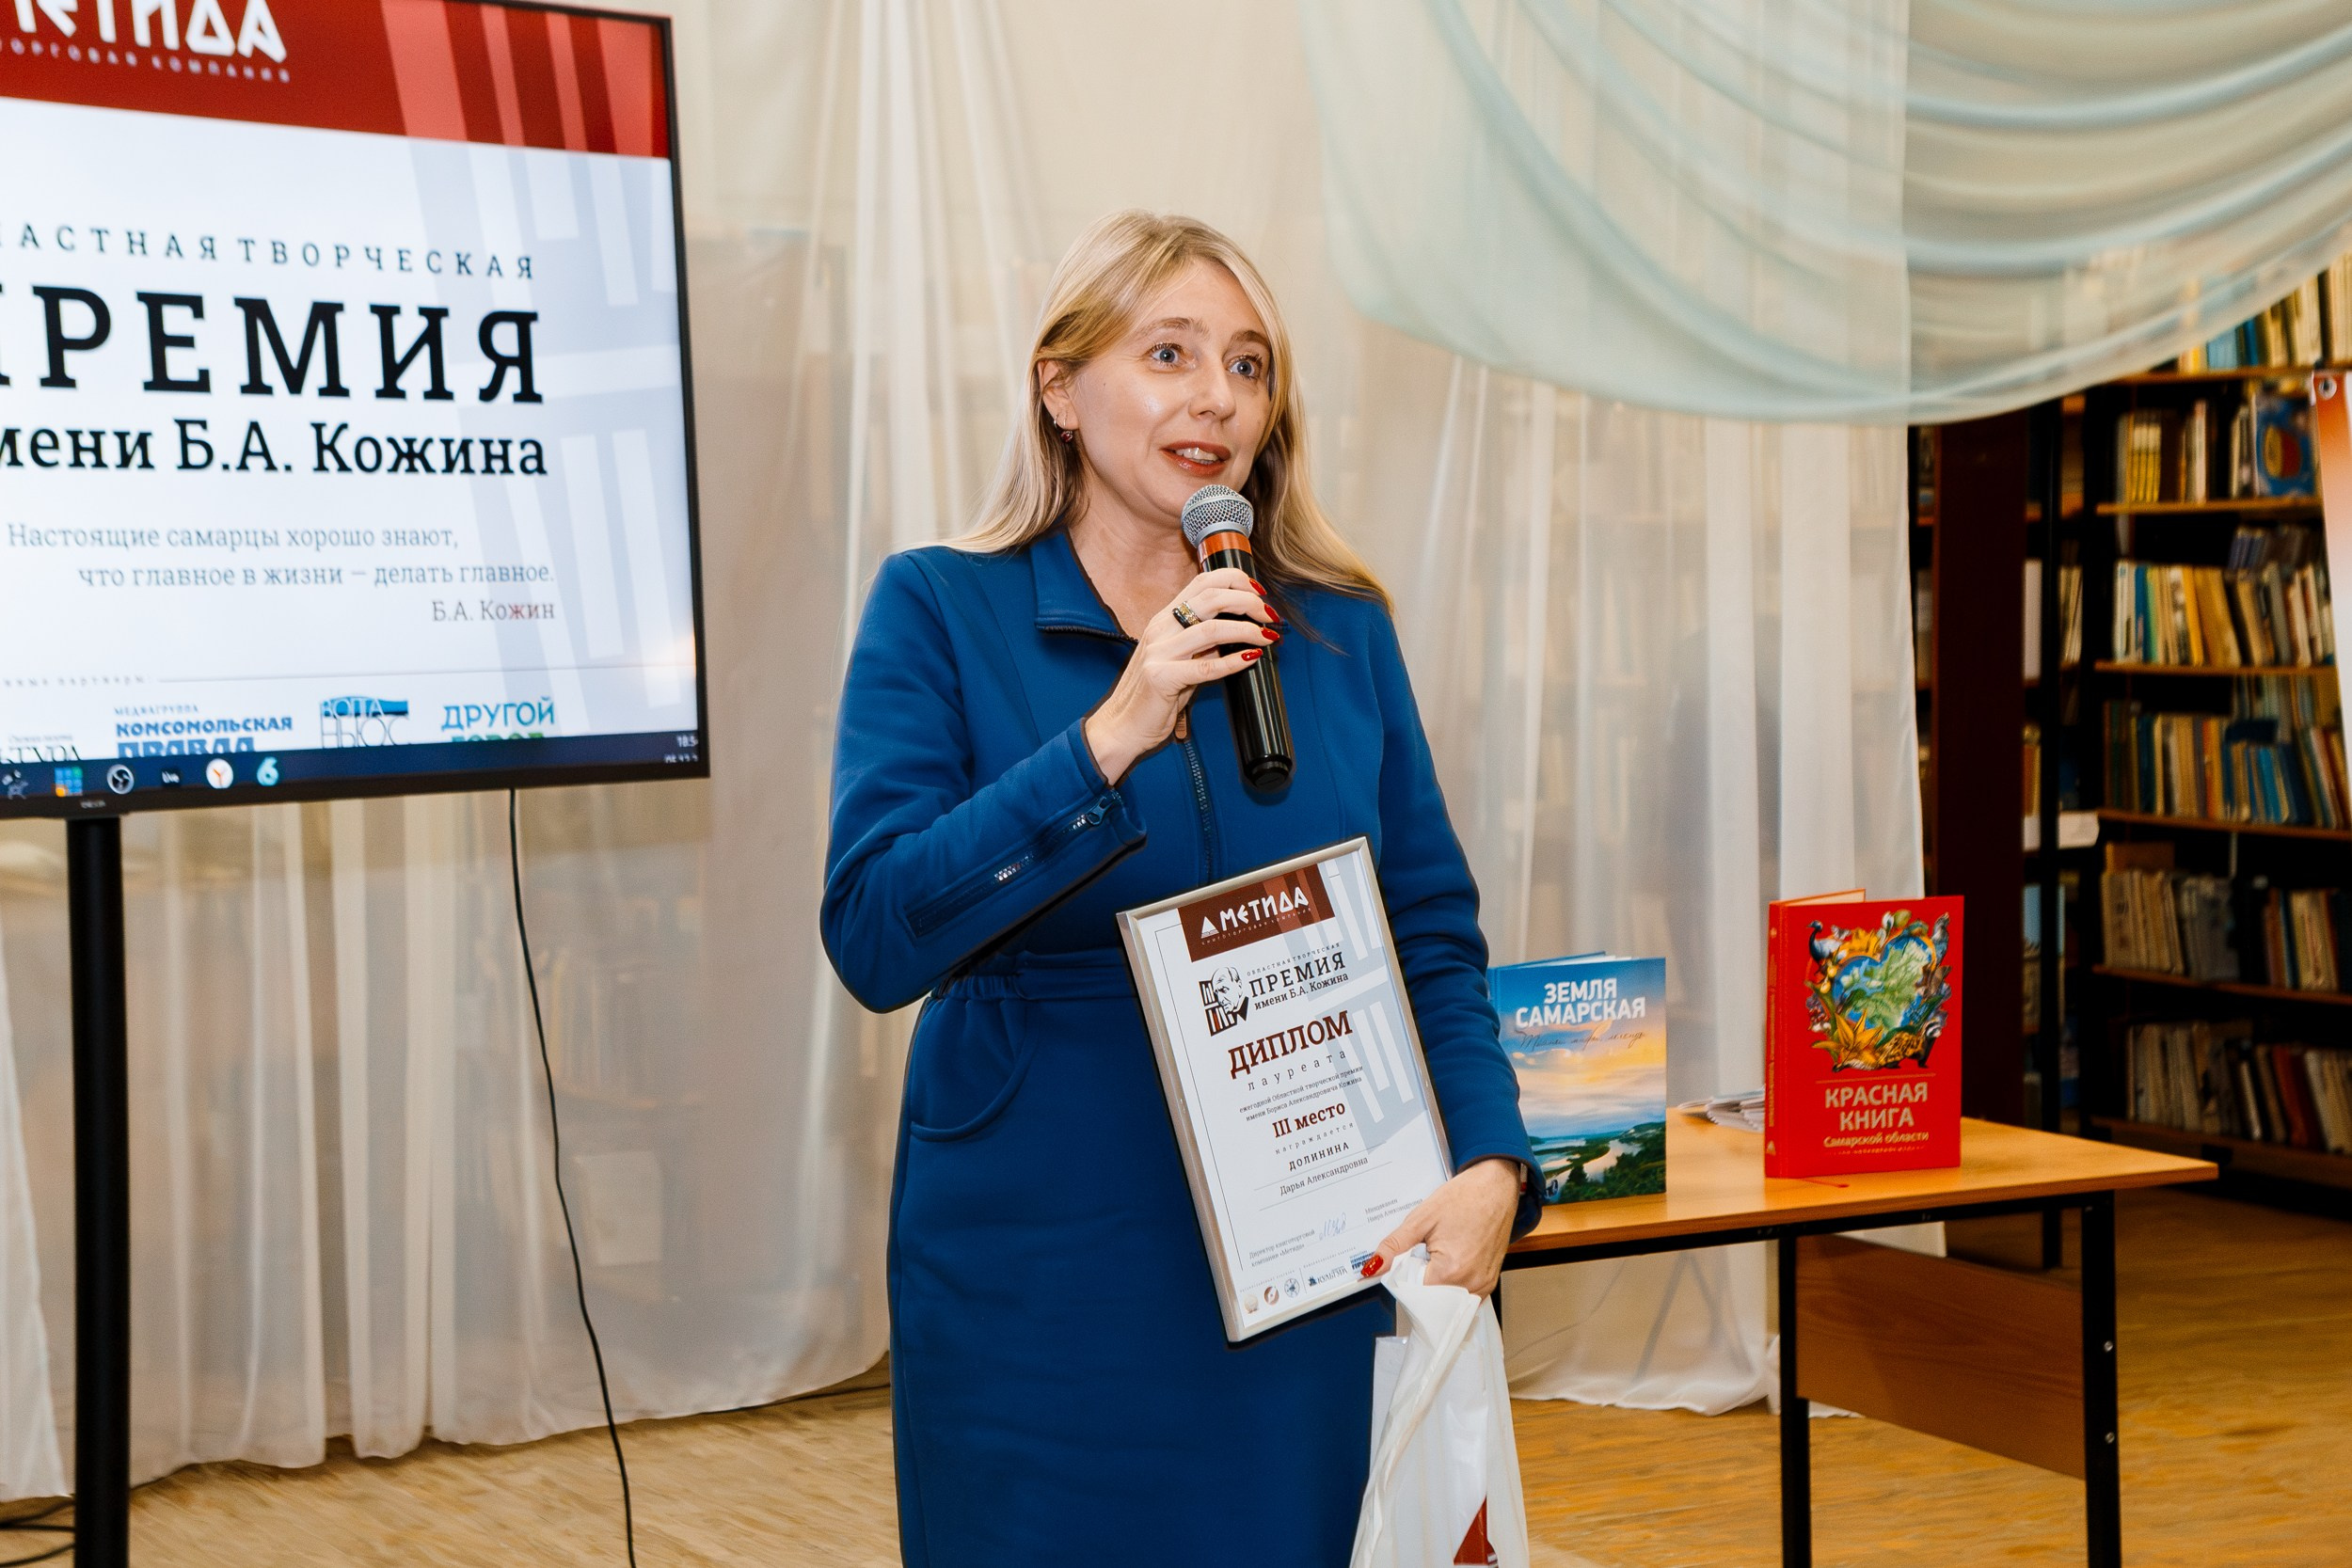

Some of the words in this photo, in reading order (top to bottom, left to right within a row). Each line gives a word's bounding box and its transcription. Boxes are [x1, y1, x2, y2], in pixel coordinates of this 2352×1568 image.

[0, 223, 217, 261] АСТНАЯ
[237, 237, 534, 280] ТВОРЧЕСКАЯ
[0, 283, 544, 404] РЕМИЯ
[173, 418, 294, 472] Б.А.
[310, 421, 549, 475] Кожина
[8, 522, 161, 551] Настоящие
[167, 528, 280, 553] самарцы
[286, 528, 375, 552] хорошо
[381, 528, 459, 549] знают,
[77, 567, 125, 588] что
[133, 567, 236, 588] главное
[242, 567, 257, 586] в
[262, 566, 343, 586] жизни
[373, 565, 454, 588] делать
[459, 564, 555, 584] главное.
[431, 599, 474, 623] Б.А.
[480, 599, 556, 621] Кожин
[115, 717, 294, 738] КОМСОМОЛЬСКАЯ
[440, 695, 556, 732] ДРУГОЙ
[1219, 886, 1310, 931] МЕТИДА
[1247, 958, 1292, 976] ОБЛАСТНАЯ
[1292, 942, 1340, 962] ТВОРЧЕСКАЯ
[1248, 951, 1346, 998] ПРЕМИЯ
[1254, 993, 1289, 1011] имени
[1289, 985, 1309, 999] Б.А.
[1309, 973, 1349, 992] Кожина
[1543, 977, 1617, 1005] ЗЕМЛЯ
[1515, 996, 1646, 1029] САМАРСКАЯ
[1228, 1009, 1353, 1080] ДИПЛОМ
[1248, 1050, 1345, 1092] лауреата
[1239, 1098, 1272, 1114] ежегодной
[1272, 1085, 1304, 1101] Областной
[1305, 1073, 1340, 1091] творческой
[1340, 1065, 1363, 1079] премии
[1246, 1110, 1266, 1122] имени
[1266, 1102, 1288, 1116] Бориса
[1288, 1084, 1338, 1106] Александровича
[1338, 1077, 1362, 1089] Кожина
[1825, 1082, 1929, 1109] КРАСНАЯ
[1272, 1117, 1293, 1138] III
[1294, 1102, 1345, 1131] место
[1839, 1106, 1915, 1132] КНИГА
[1275, 1122, 1354, 1155] награждается
[1823, 1132, 1883, 1148] Самарской
[1884, 1131, 1930, 1144] области
[1288, 1142, 1349, 1172] ДОЛИНИНА
[1279, 1180, 1305, 1196] Дарья
[1307, 1157, 1368, 1185] Александровна
[1248, 1244, 1275, 1260] Директор
